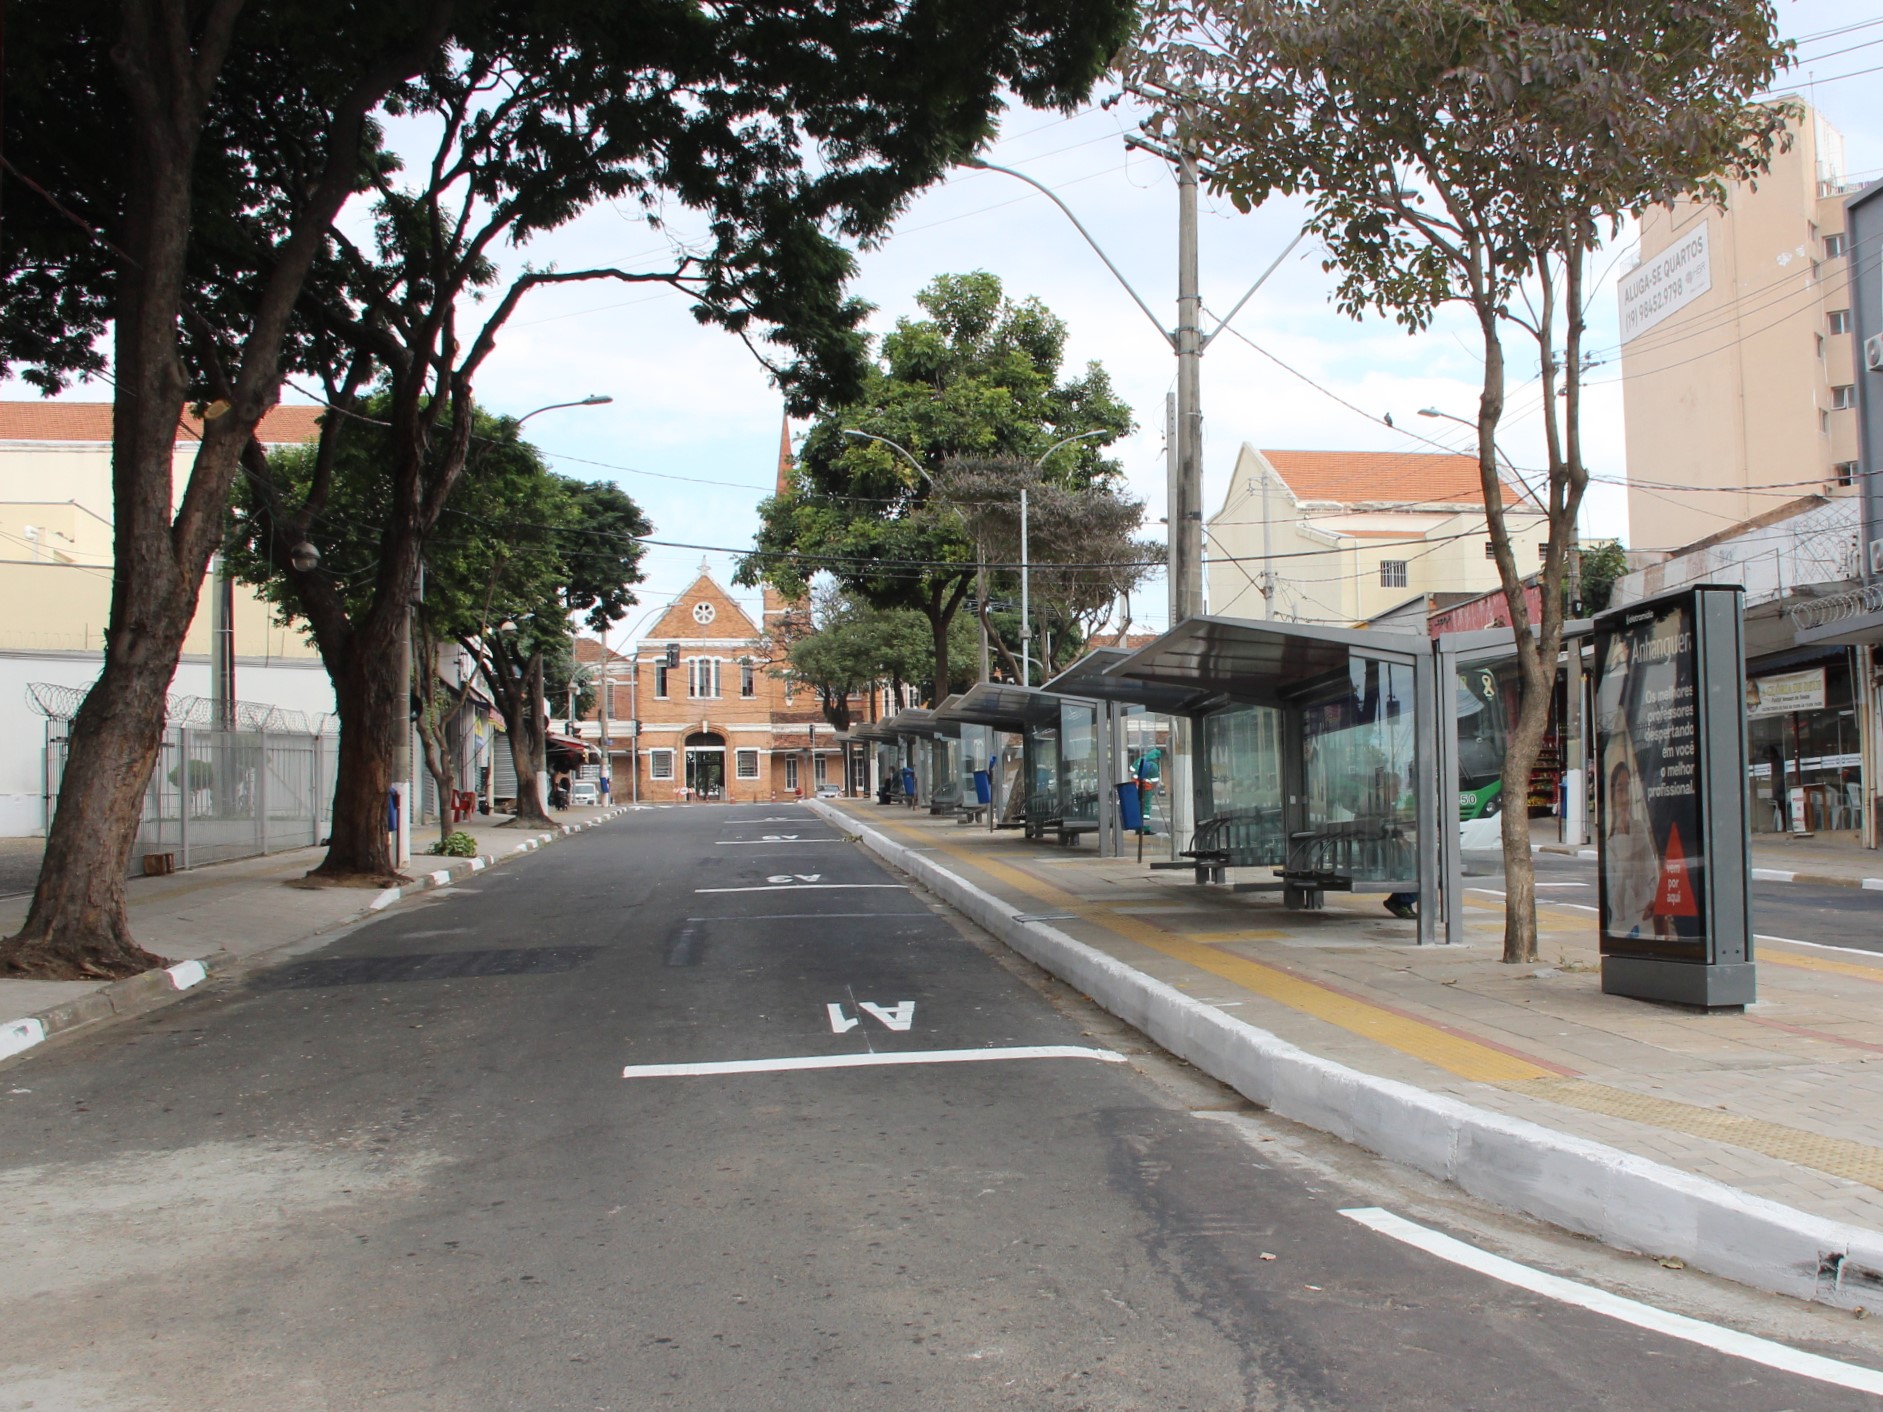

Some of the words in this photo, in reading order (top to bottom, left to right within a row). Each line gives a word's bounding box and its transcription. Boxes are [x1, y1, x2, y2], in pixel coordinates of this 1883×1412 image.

[1624, 264, 1662, 305] ALUGA-SE
[1664, 236, 1704, 278] QUARTOS
[1625, 308, 1638, 332] (19)
[1639, 278, 1683, 320] 98452.9798
[1631, 631, 1692, 666] Anhanguer
[1645, 690, 1657, 704] Os
[1657, 684, 1693, 702] melhores
[1648, 704, 1693, 725] professores
[1644, 723, 1694, 744] despertando
[1662, 747, 1674, 758] em
[1676, 742, 1695, 757] você
[1660, 766, 1666, 777] o
[1667, 762, 1695, 776] melhor
[1460, 793, 1477, 805] 50
[1647, 780, 1696, 801] profissional.
[1666, 864, 1681, 873] vem
[1667, 878, 1679, 891] por
[1666, 891, 1681, 906] aqui
[827, 1000, 915, 1034] A1
